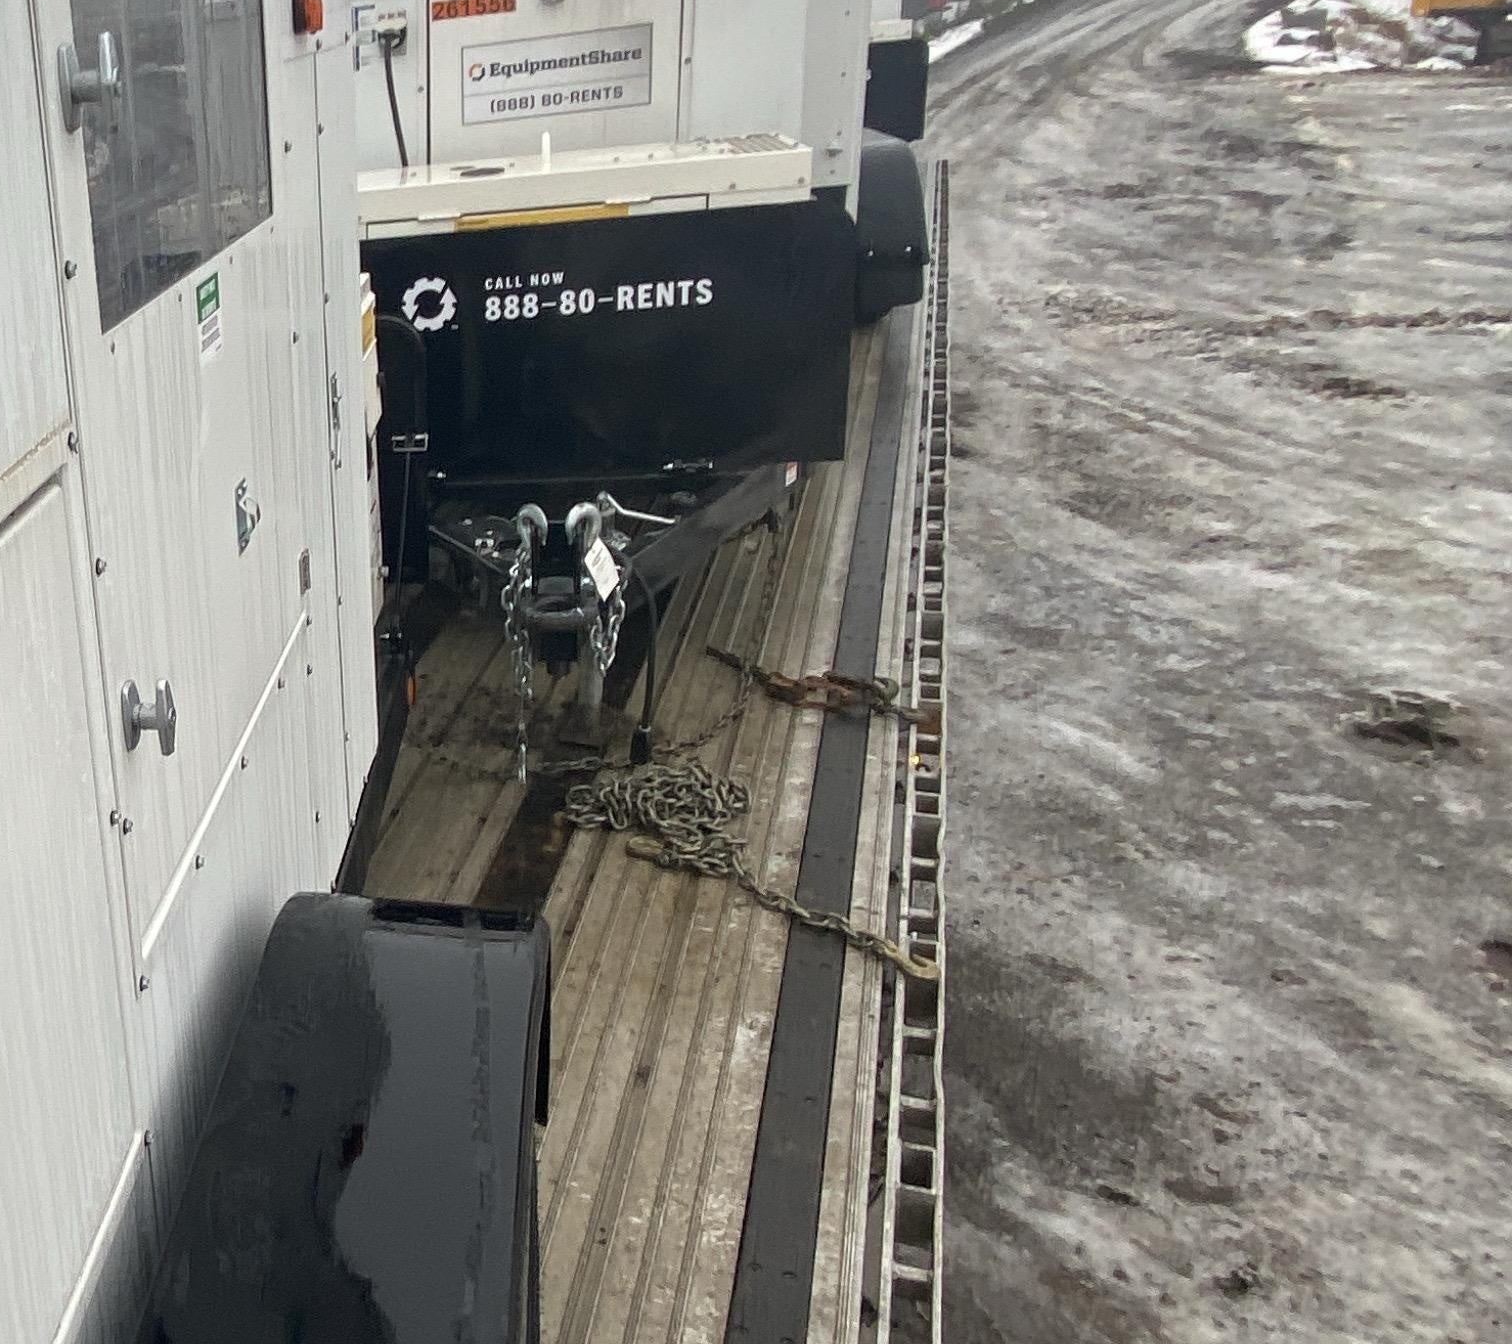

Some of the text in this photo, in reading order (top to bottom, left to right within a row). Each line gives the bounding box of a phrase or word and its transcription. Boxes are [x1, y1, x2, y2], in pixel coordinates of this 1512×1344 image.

[489, 48, 643, 77] EquipmentShare
[490, 86, 624, 113] (888) 80-RENTS
[485, 272, 565, 290] CALL NOW
[485, 278, 714, 322] 888-80-RENTS
